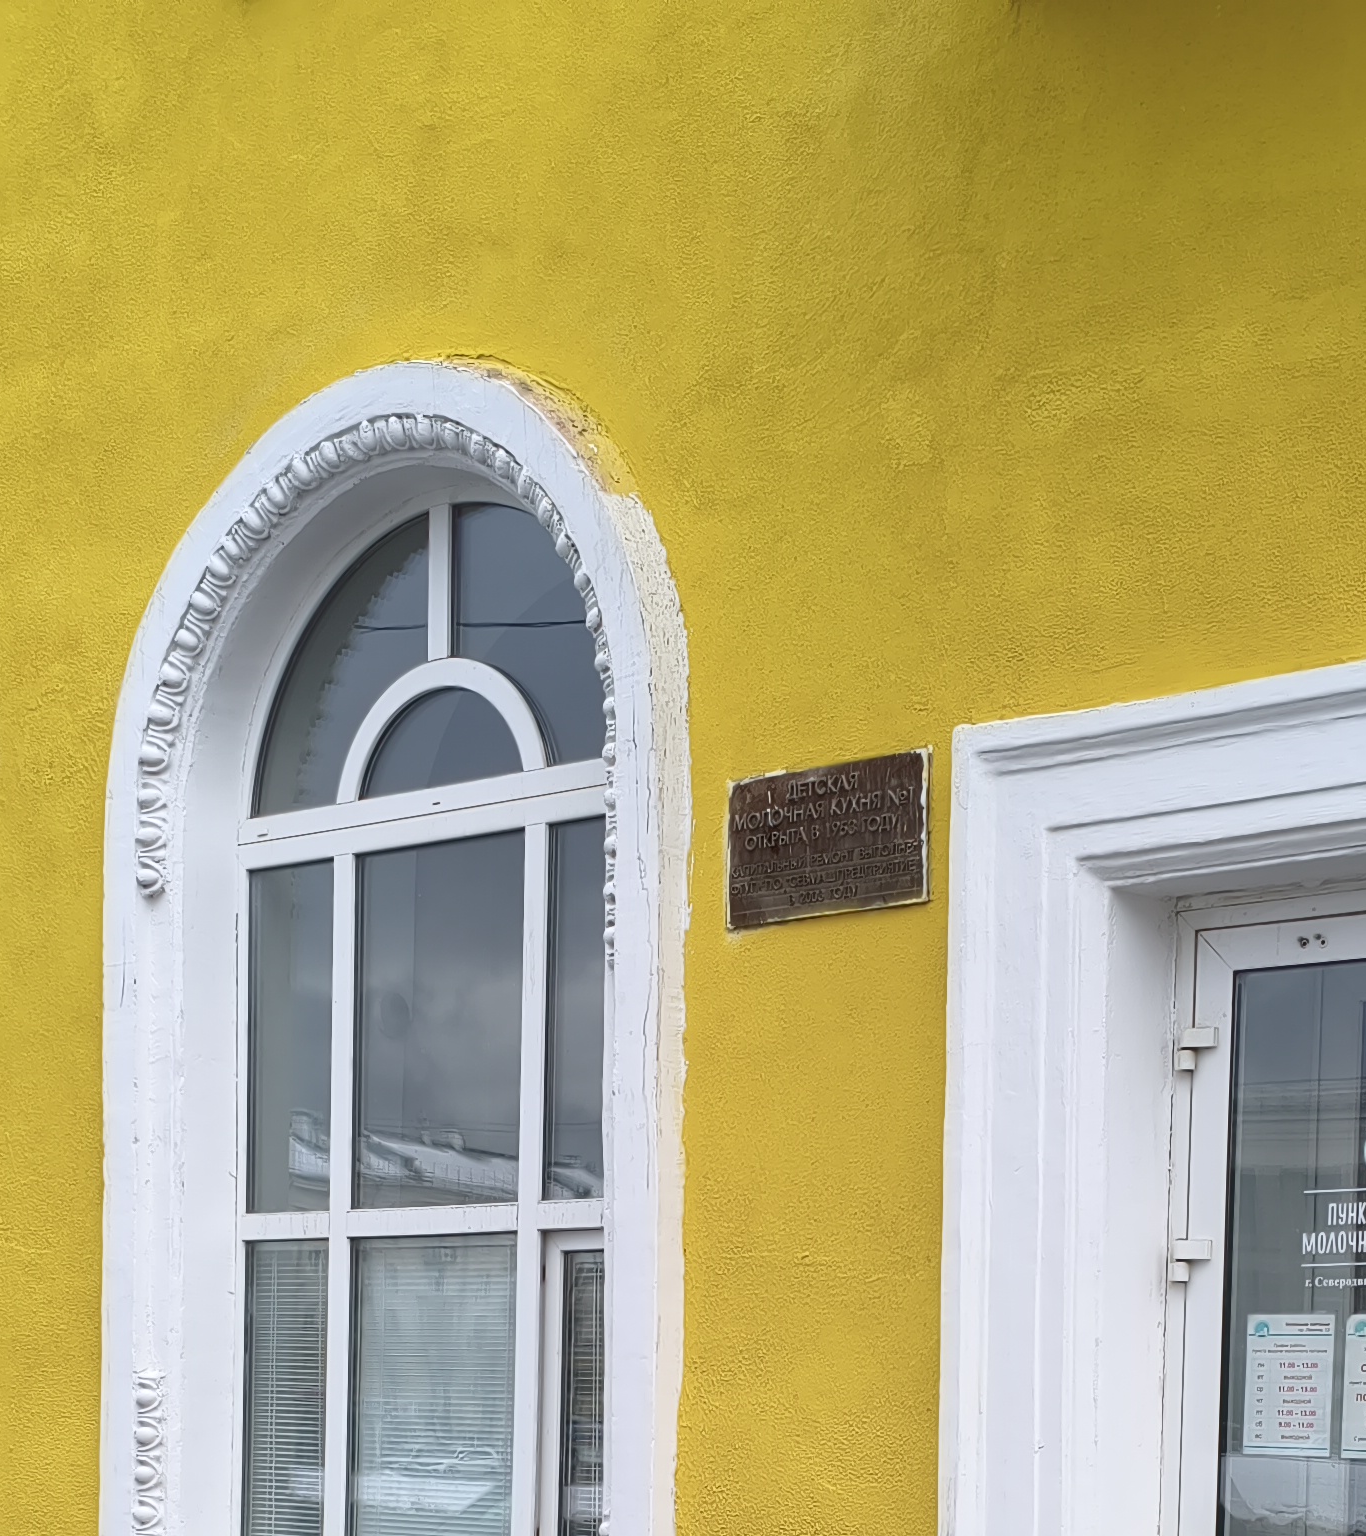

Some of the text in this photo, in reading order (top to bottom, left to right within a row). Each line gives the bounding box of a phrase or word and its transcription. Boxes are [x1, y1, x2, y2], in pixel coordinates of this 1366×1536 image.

[786, 772, 859, 803] ДЕТСКАЯ
[733, 800, 825, 832] МОЛОЧНАЯ
[830, 789, 881, 815] КУХНЯ
[745, 826, 809, 850] ОТКРЫТА
[812, 825, 819, 839] В
[861, 813, 898, 833] ГОДУ
[1305, 1279, 1313, 1287] г.
[1360, 1363, 1366, 1373] С
